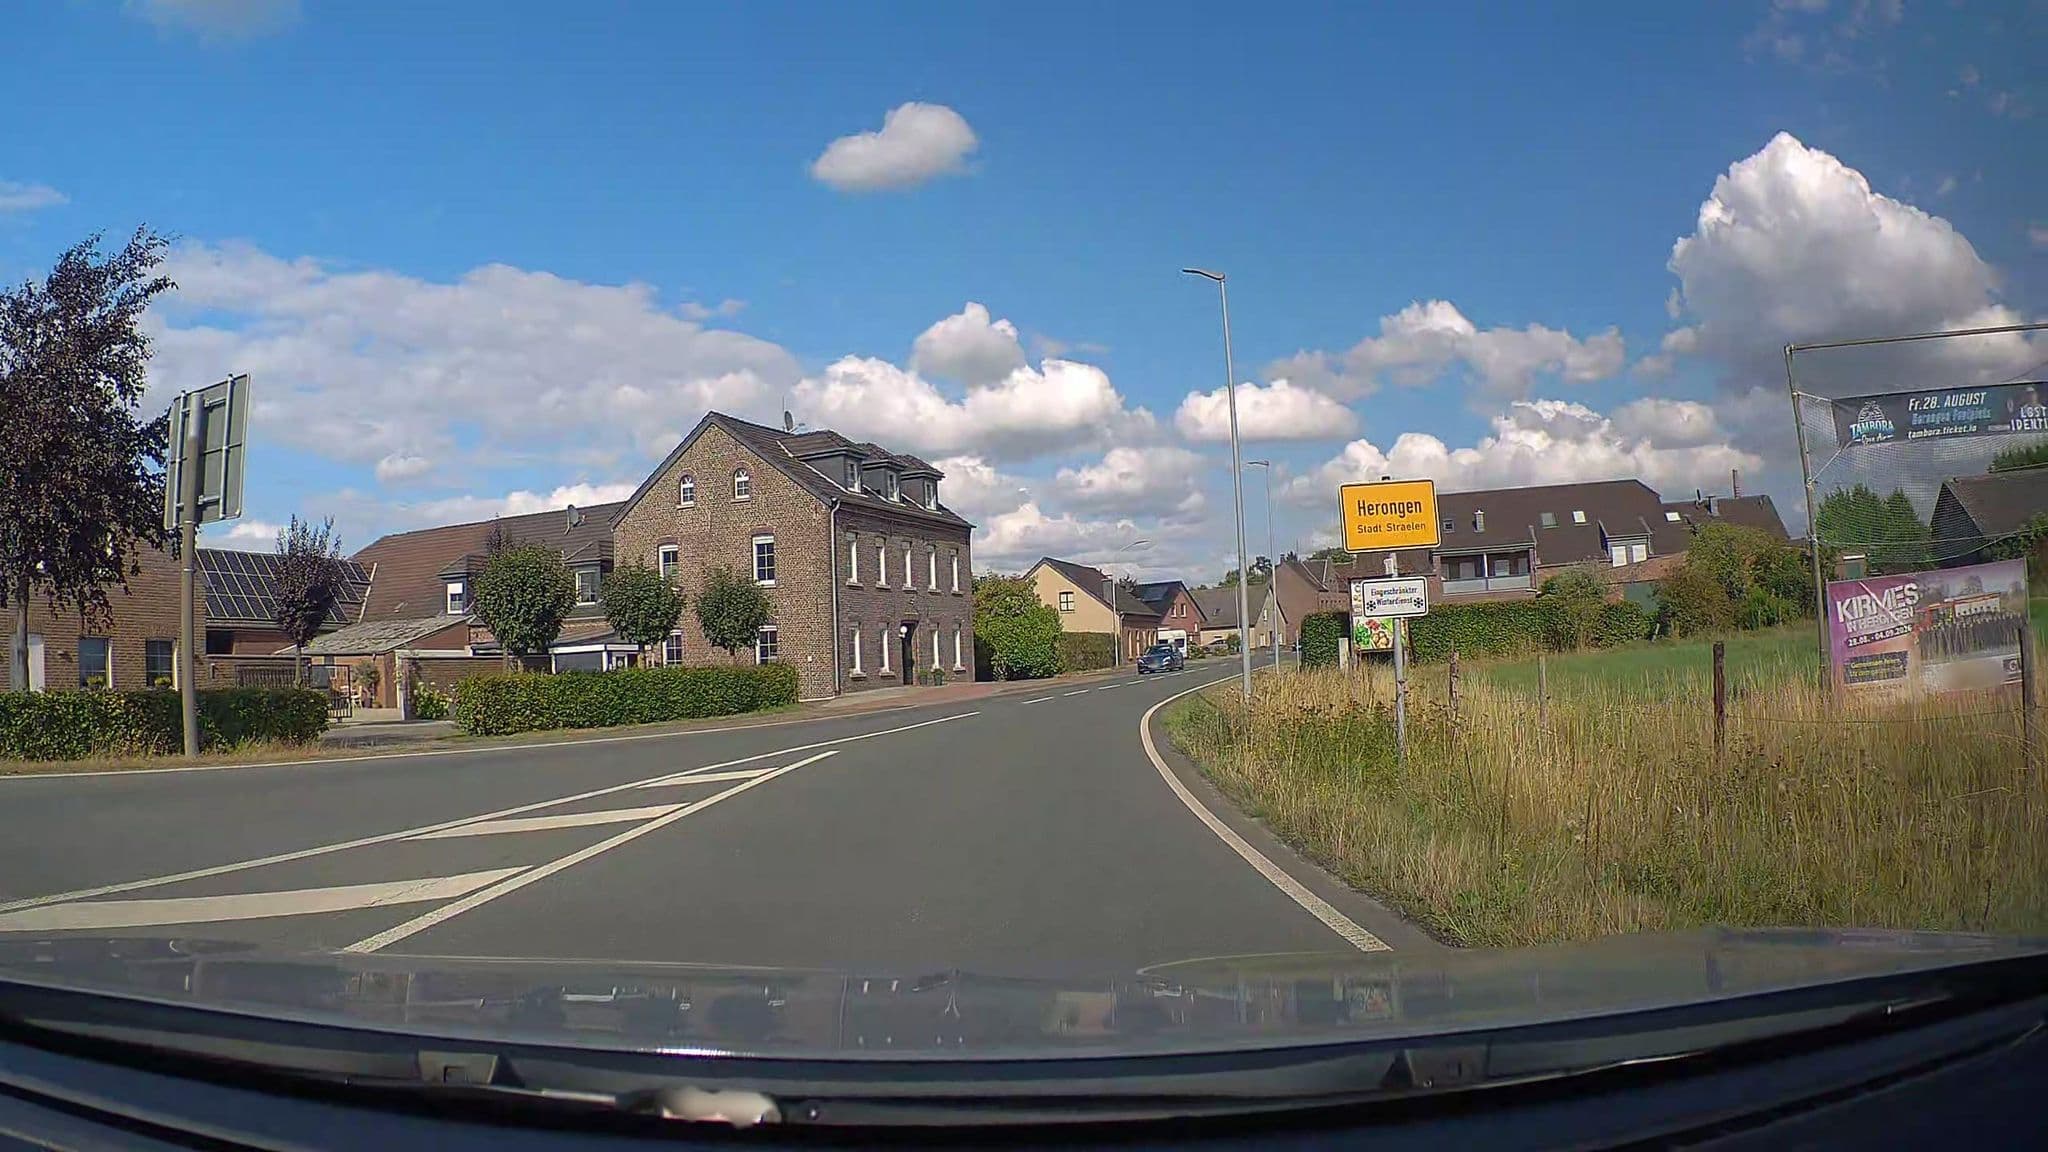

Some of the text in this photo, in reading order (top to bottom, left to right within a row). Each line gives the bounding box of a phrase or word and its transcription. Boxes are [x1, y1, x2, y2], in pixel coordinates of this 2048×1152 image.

[1944, 392, 1987, 407] AUGUST
[2021, 406, 2047, 418] LOST
[1849, 420, 1895, 438] TAMBORA
[1357, 500, 1422, 518] Herongen
[1357, 522, 1426, 533] Stadt Straelen
[1836, 583, 1919, 623] KIRMES
